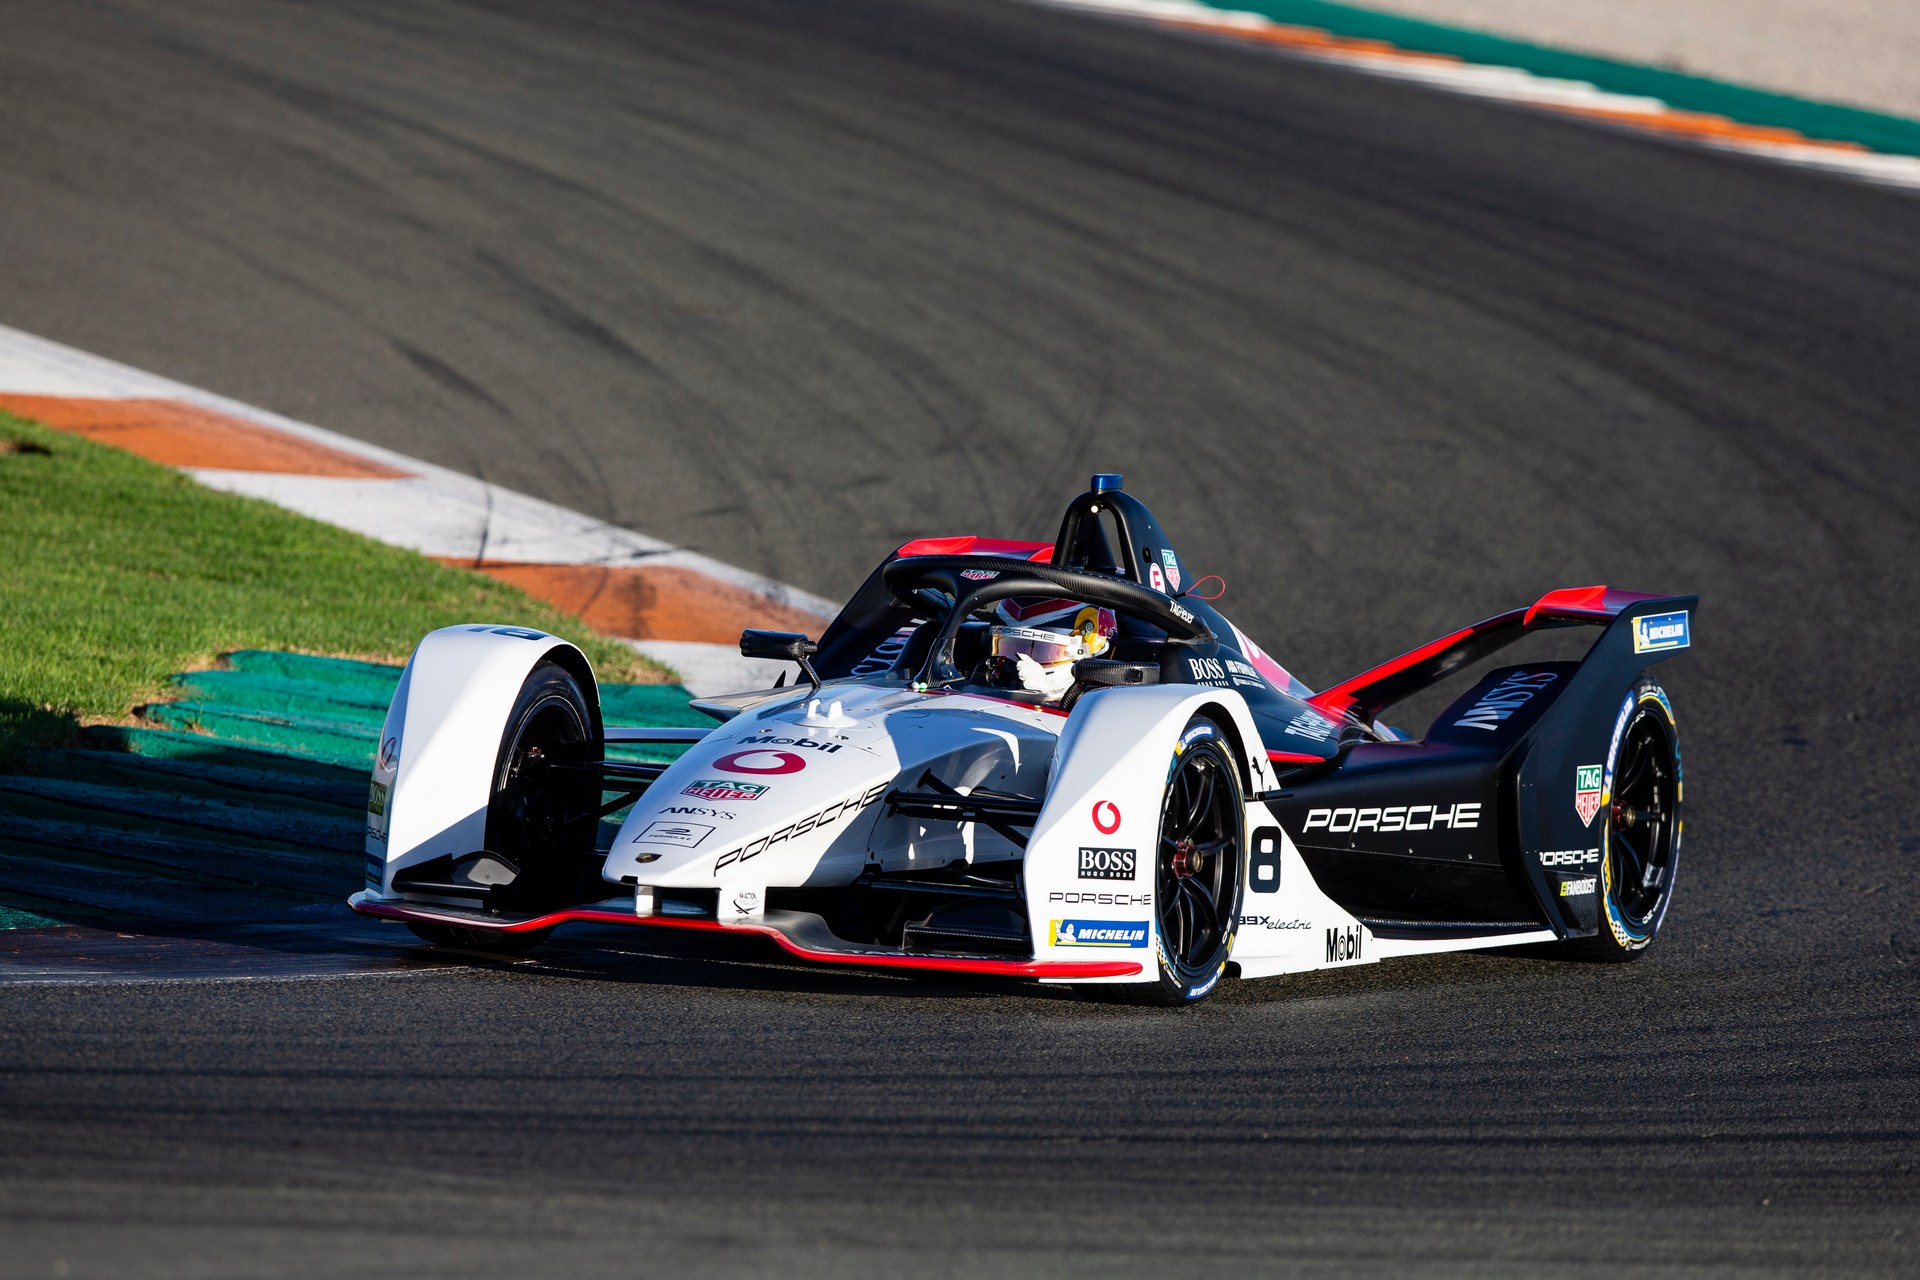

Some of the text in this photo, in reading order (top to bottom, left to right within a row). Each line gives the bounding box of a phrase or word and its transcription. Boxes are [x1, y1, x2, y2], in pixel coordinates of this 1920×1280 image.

[1649, 623, 1684, 640] MICHELIN
[1188, 658, 1225, 680] BOSS
[737, 736, 842, 754] Mobil
[700, 781, 758, 792] TAG
[1579, 768, 1600, 789] TAG
[687, 787, 757, 799] HEUER
[658, 807, 737, 820] ANSYS
[1577, 792, 1599, 822] HEUER
[1302, 803, 1482, 833] PORSCHE
[713, 781, 890, 878] PORSCHE
[1080, 850, 1134, 871] BOSS
[1249, 826, 1282, 893] 8
[1566, 879, 1597, 896] FANBOOST
[1049, 892, 1152, 905] PORSCHE
[1266, 918, 1312, 930] electric
[1078, 929, 1145, 941] MICHELIN
[1326, 925, 1363, 963] Mobil
